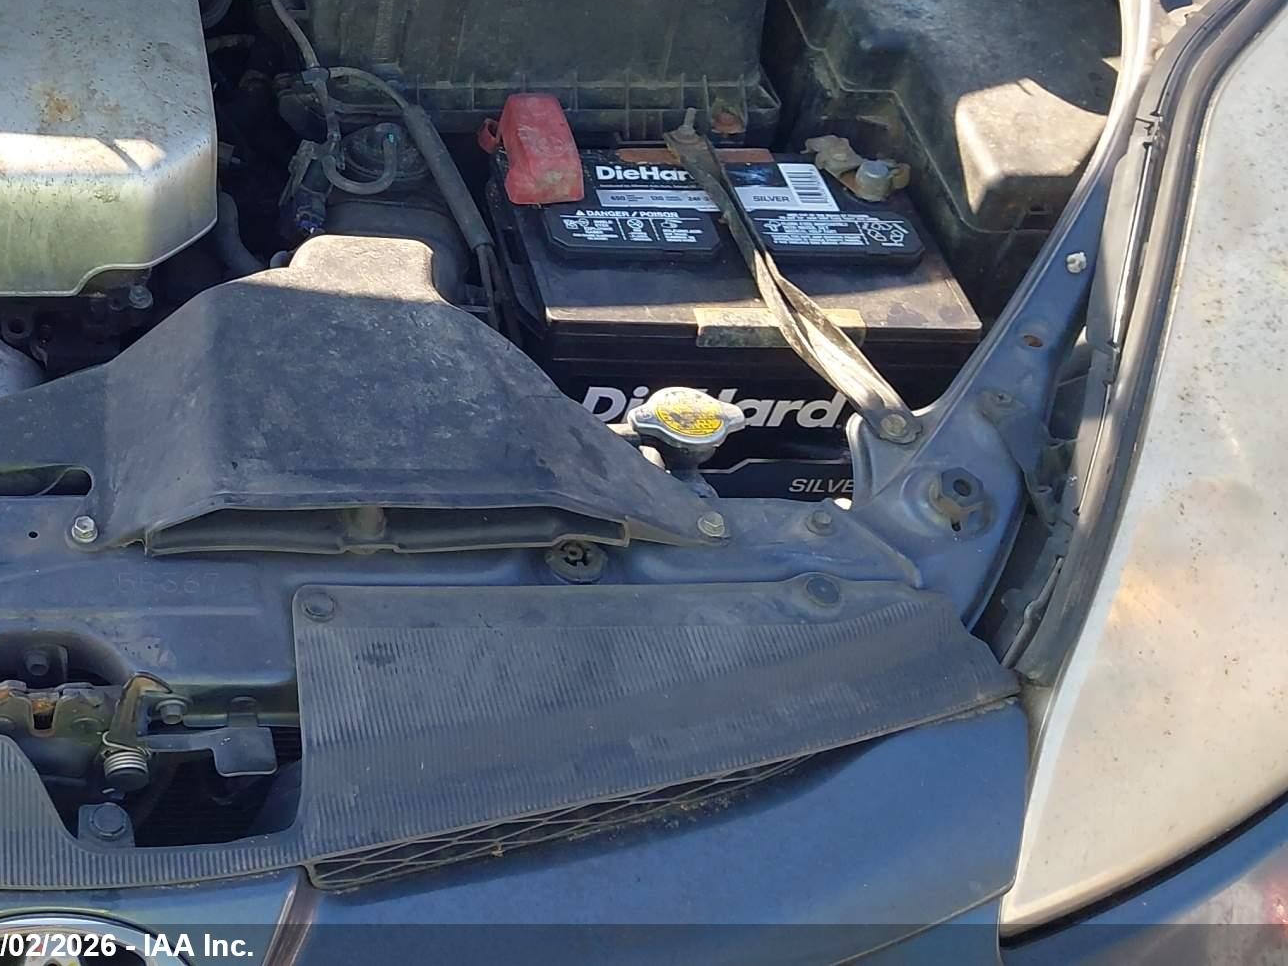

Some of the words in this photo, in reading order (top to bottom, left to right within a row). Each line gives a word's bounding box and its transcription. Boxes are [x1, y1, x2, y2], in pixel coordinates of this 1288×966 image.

[595, 165, 693, 181] DieHar
[639, 211, 680, 219] POISON
[580, 386, 846, 428] Diard
[788, 478, 855, 493] SILVE
